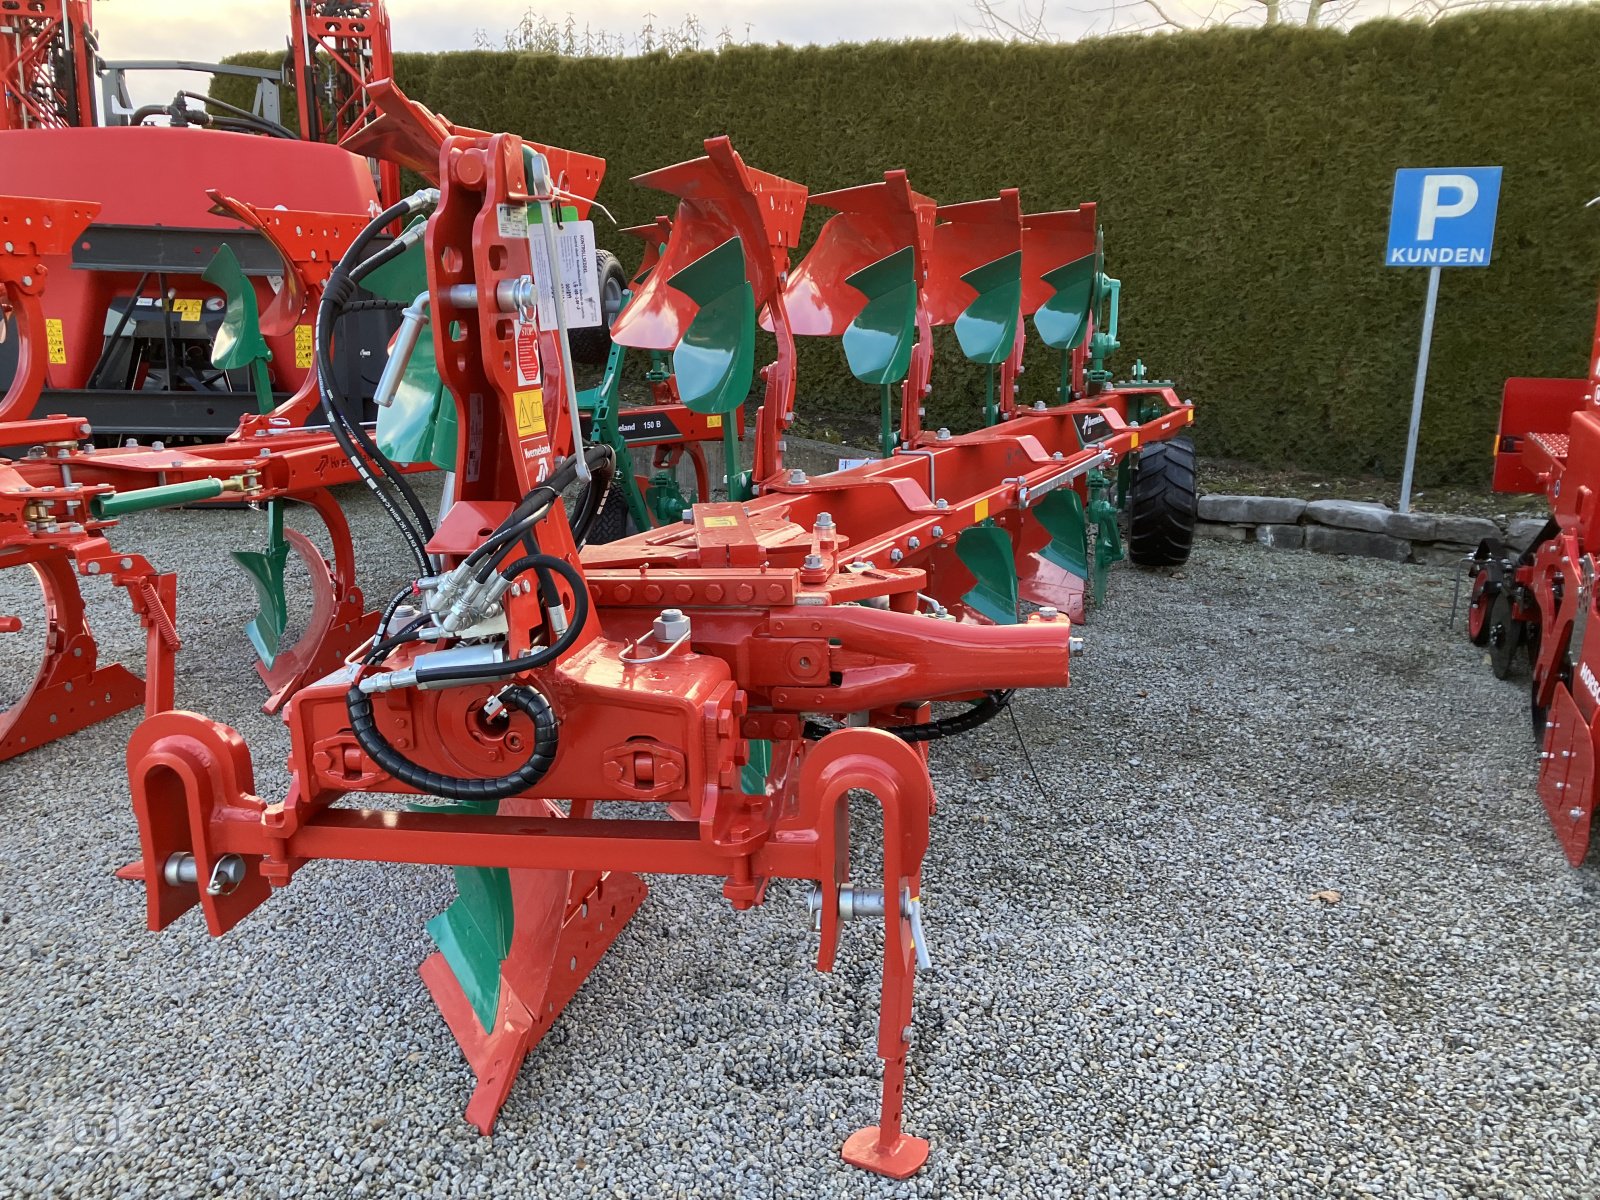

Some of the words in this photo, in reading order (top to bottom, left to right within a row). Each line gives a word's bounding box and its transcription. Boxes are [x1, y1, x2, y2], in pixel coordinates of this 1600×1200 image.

[1417, 174, 1479, 241] P
[1391, 247, 1485, 263] KUNDEN
[643, 421, 655, 430] 150
[656, 420, 662, 429] B
